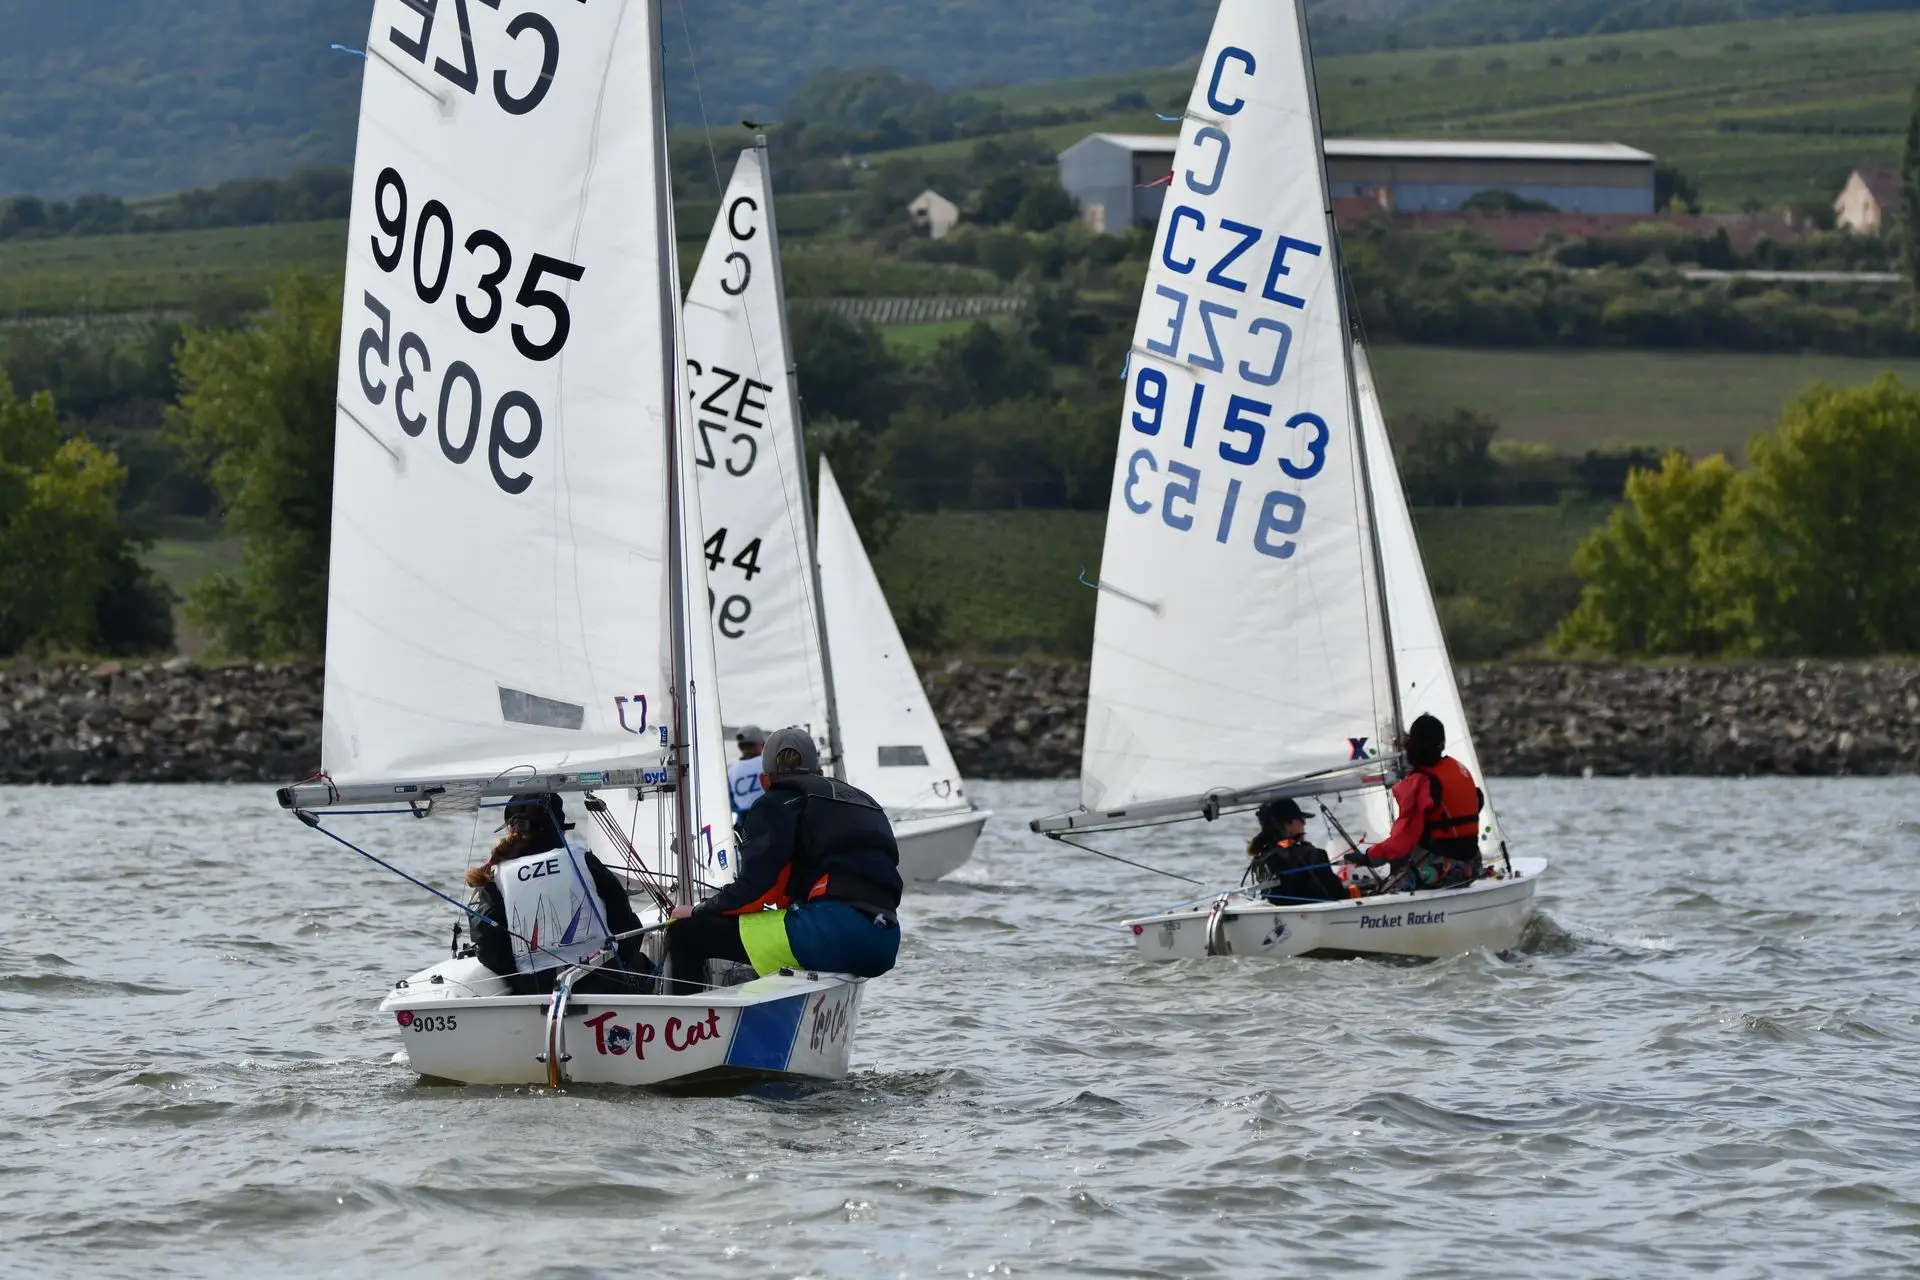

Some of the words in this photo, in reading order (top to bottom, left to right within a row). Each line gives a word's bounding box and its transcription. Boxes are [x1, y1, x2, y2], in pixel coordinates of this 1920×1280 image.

[1207, 46, 1256, 116] C
[728, 196, 758, 241] C
[370, 166, 586, 362] 9035
[1162, 204, 1323, 310] CZE
[1131, 367, 1330, 481] 9153
[734, 773, 762, 796] CZ
[517, 858, 561, 882] CZE
[1360, 915, 1402, 929] Pocket
[1406, 911, 1445, 925] Rocket
[413, 1015, 457, 1033] 9035
[583, 1011, 655, 1060] Top
[664, 1008, 721, 1052] Cat
